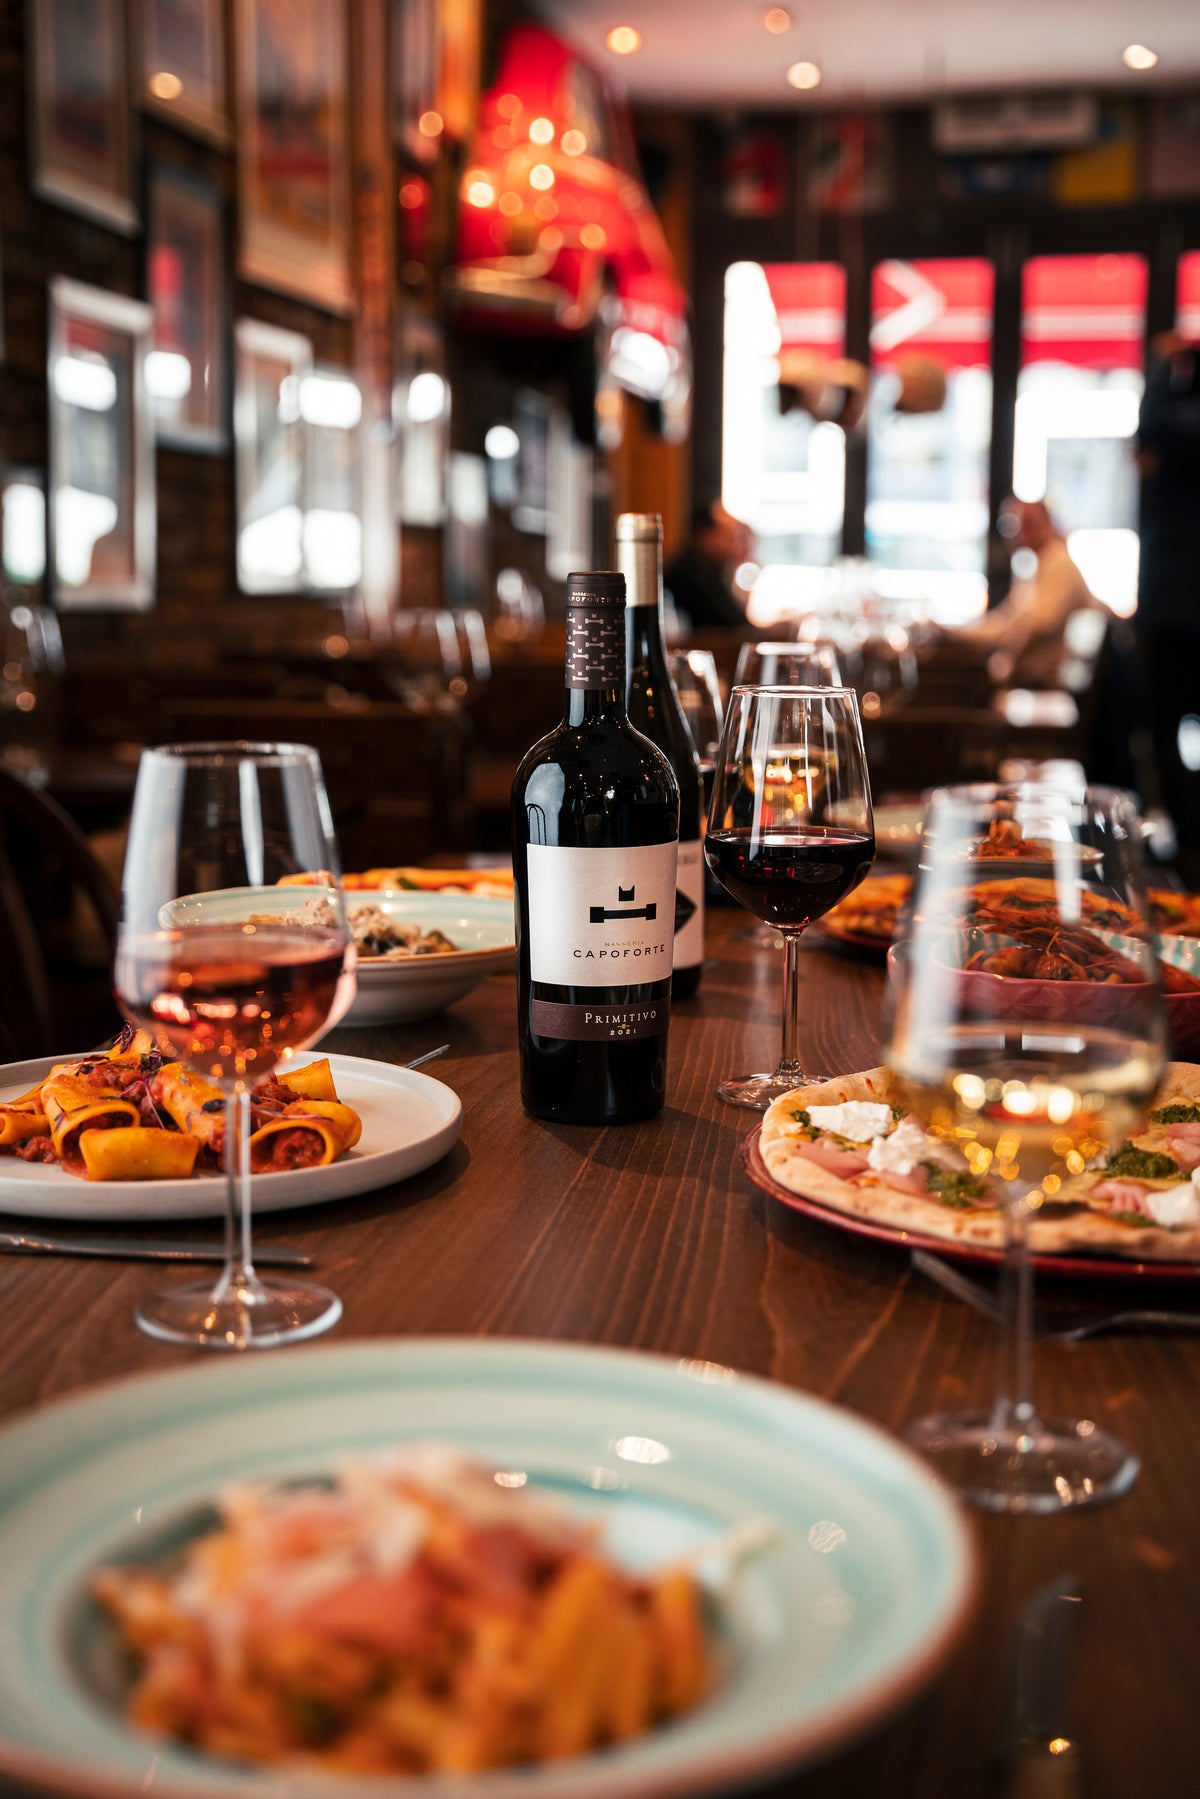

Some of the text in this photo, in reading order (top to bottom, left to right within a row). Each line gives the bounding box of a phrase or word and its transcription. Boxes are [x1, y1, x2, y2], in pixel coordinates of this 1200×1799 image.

[573, 944, 665, 958] CAPOFORTE
[585, 1010, 657, 1024] PRIMITIVO
[610, 1028, 637, 1036] 2021
